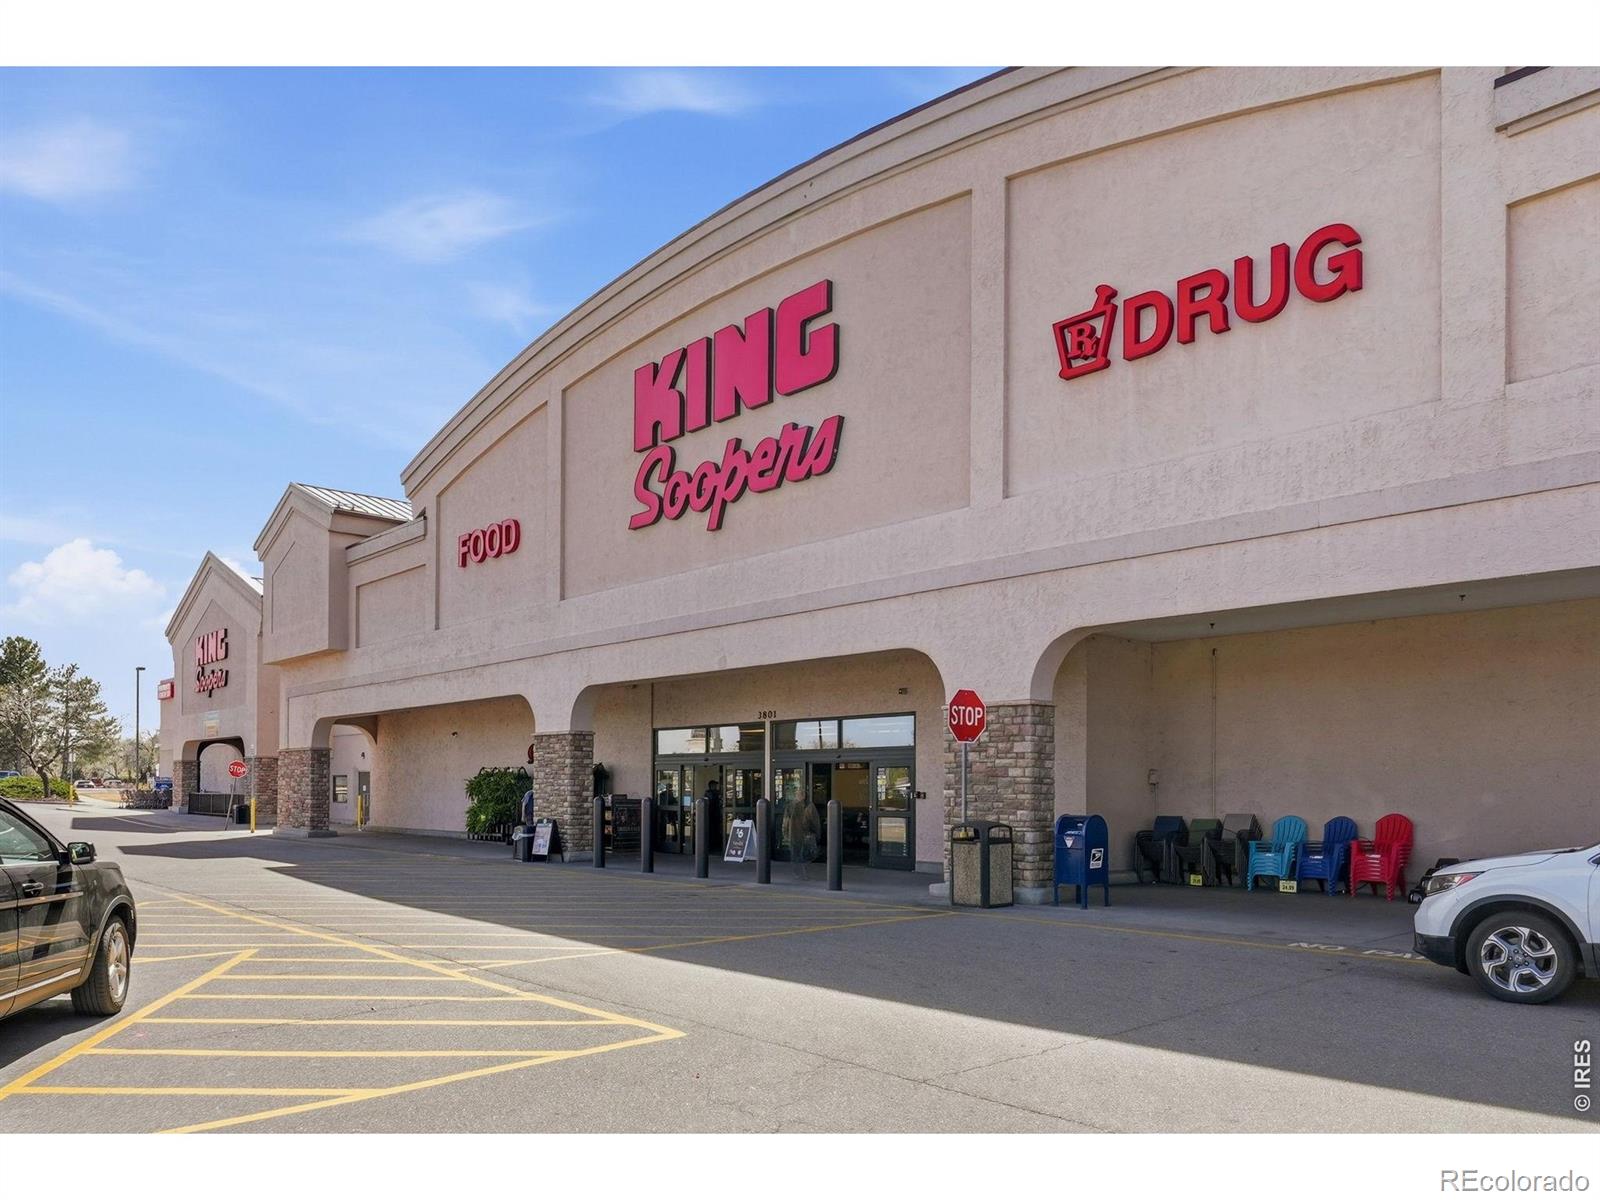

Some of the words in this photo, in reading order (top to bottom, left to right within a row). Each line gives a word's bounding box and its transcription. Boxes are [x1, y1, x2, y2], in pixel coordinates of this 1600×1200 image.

[1123, 223, 1363, 361] DRUG
[634, 279, 839, 452] KING
[628, 414, 845, 531] Soopers
[457, 518, 521, 567] FOOD
[195, 628, 228, 667] KING
[194, 666, 229, 698] Soopers
[757, 710, 777, 720] 3801
[951, 705, 983, 726] STOP
[229, 765, 246, 774] STOP
